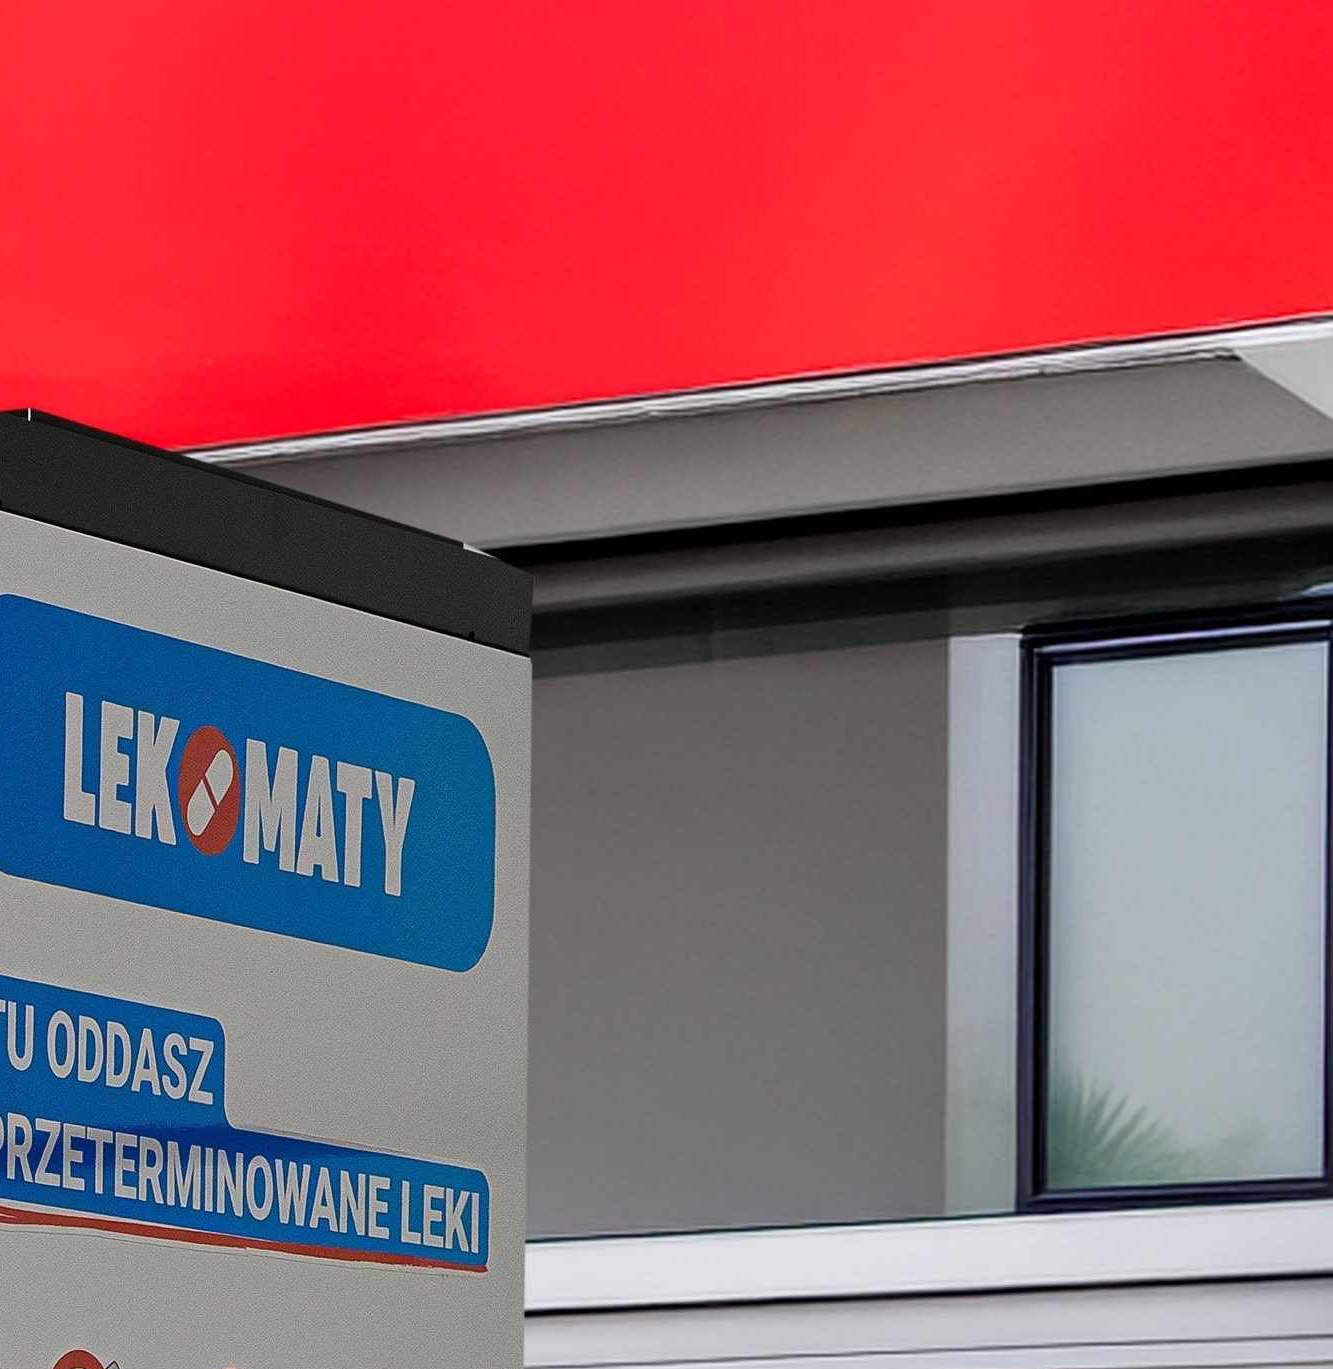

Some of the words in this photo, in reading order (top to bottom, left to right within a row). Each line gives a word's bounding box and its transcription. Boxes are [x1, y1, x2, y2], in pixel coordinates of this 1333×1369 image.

[63, 691, 416, 896] LEKOMATY
[46, 1009, 214, 1105] ODDASZ
[400, 1180, 479, 1254] LEKI
